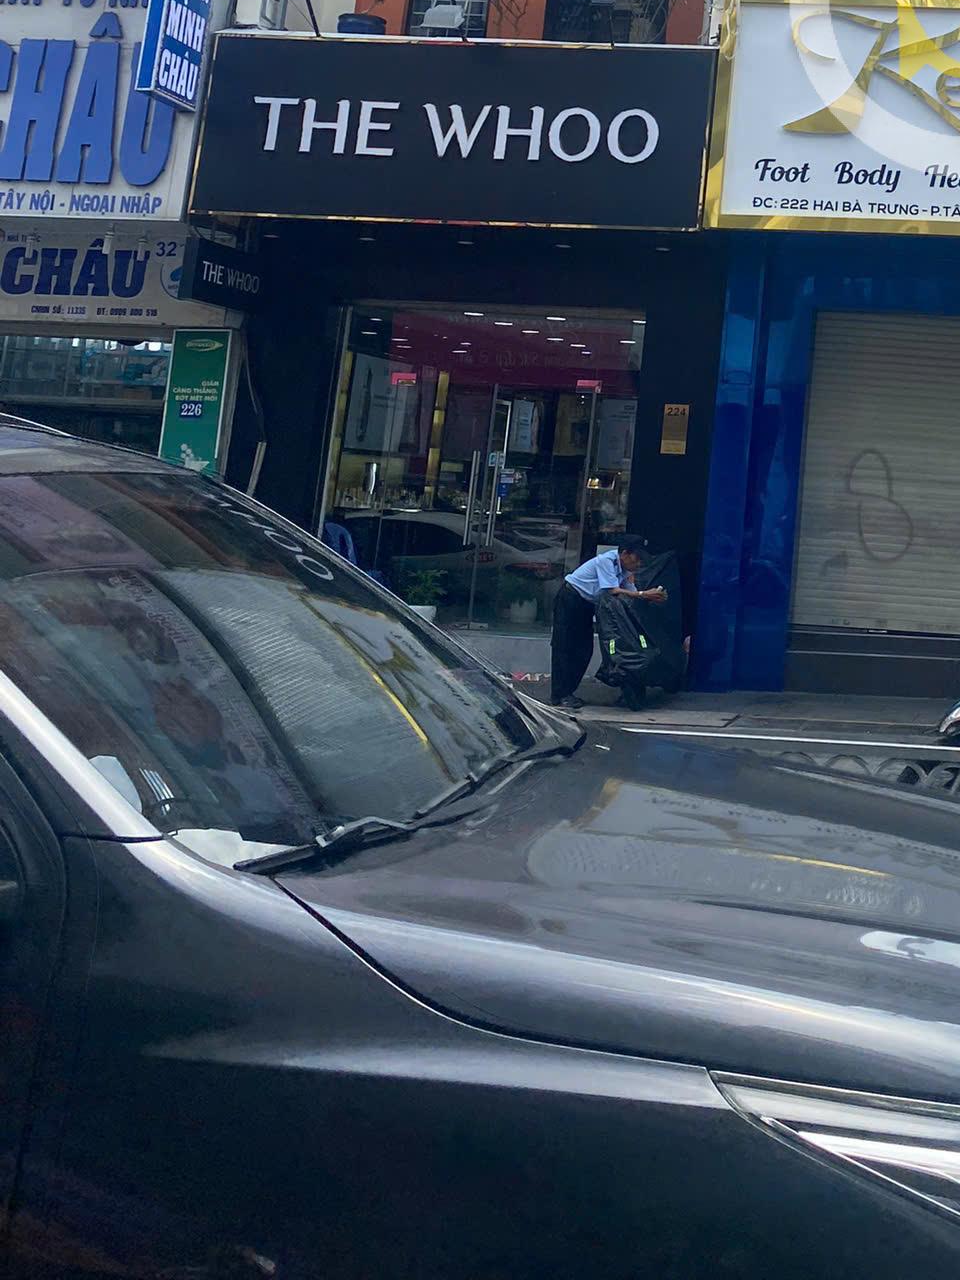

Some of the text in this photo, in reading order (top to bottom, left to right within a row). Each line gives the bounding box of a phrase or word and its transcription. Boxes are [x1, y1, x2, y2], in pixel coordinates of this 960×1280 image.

[158, 49, 199, 101] CHÂU
[253, 95, 660, 164] THE WHOO
[755, 158, 811, 183] Foot
[834, 161, 901, 193] Body
[29, 190, 56, 215] NỘI
[70, 194, 116, 216] NGOẠI
[120, 192, 162, 217] NHẬP
[813, 200, 838, 212] HAI
[843, 198, 862, 212] BÀ
[1, 237, 150, 299] CHÂU
[202, 260, 260, 294] THE WHOO
[180, 403, 202, 416] 226
[667, 407, 686, 417] 224
